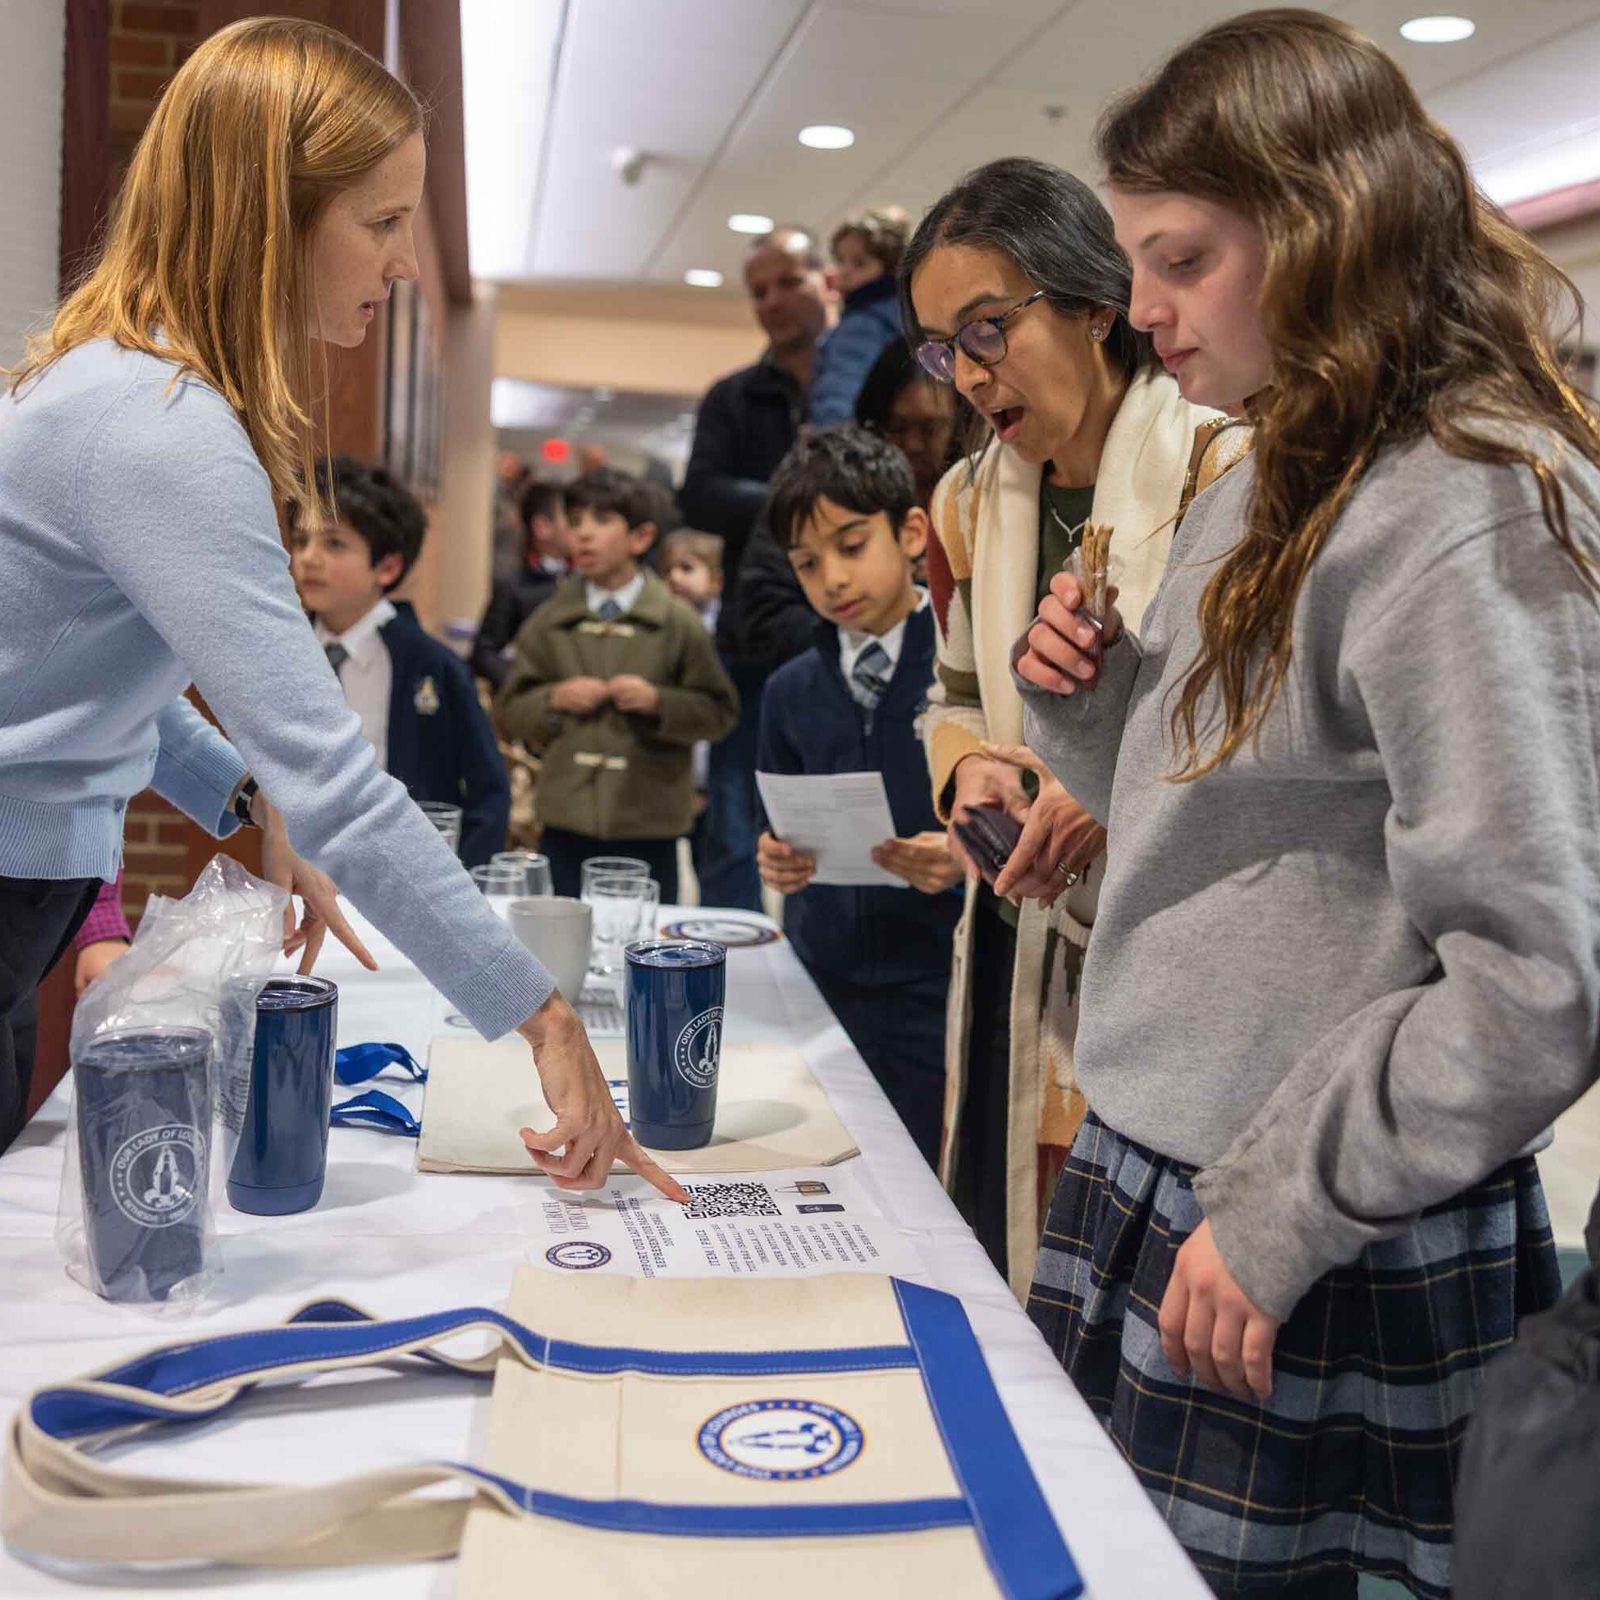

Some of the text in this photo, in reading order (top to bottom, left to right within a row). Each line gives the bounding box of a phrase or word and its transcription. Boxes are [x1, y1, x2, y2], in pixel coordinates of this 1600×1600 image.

[681, 1028, 695, 1045] OUR
[693, 1013, 711, 1029] LADY
[117, 1148, 135, 1169] OUR
[132, 1132, 159, 1150] LADY
[162, 1129, 176, 1140] OF
[542, 1202, 568, 1233] CHURCH
[647, 1235, 666, 1268] REPRESENT
[695, 1230, 711, 1245] PRICE
[638, 1251, 655, 1278] SUPPORT
[704, 1250, 720, 1266] ITEM
